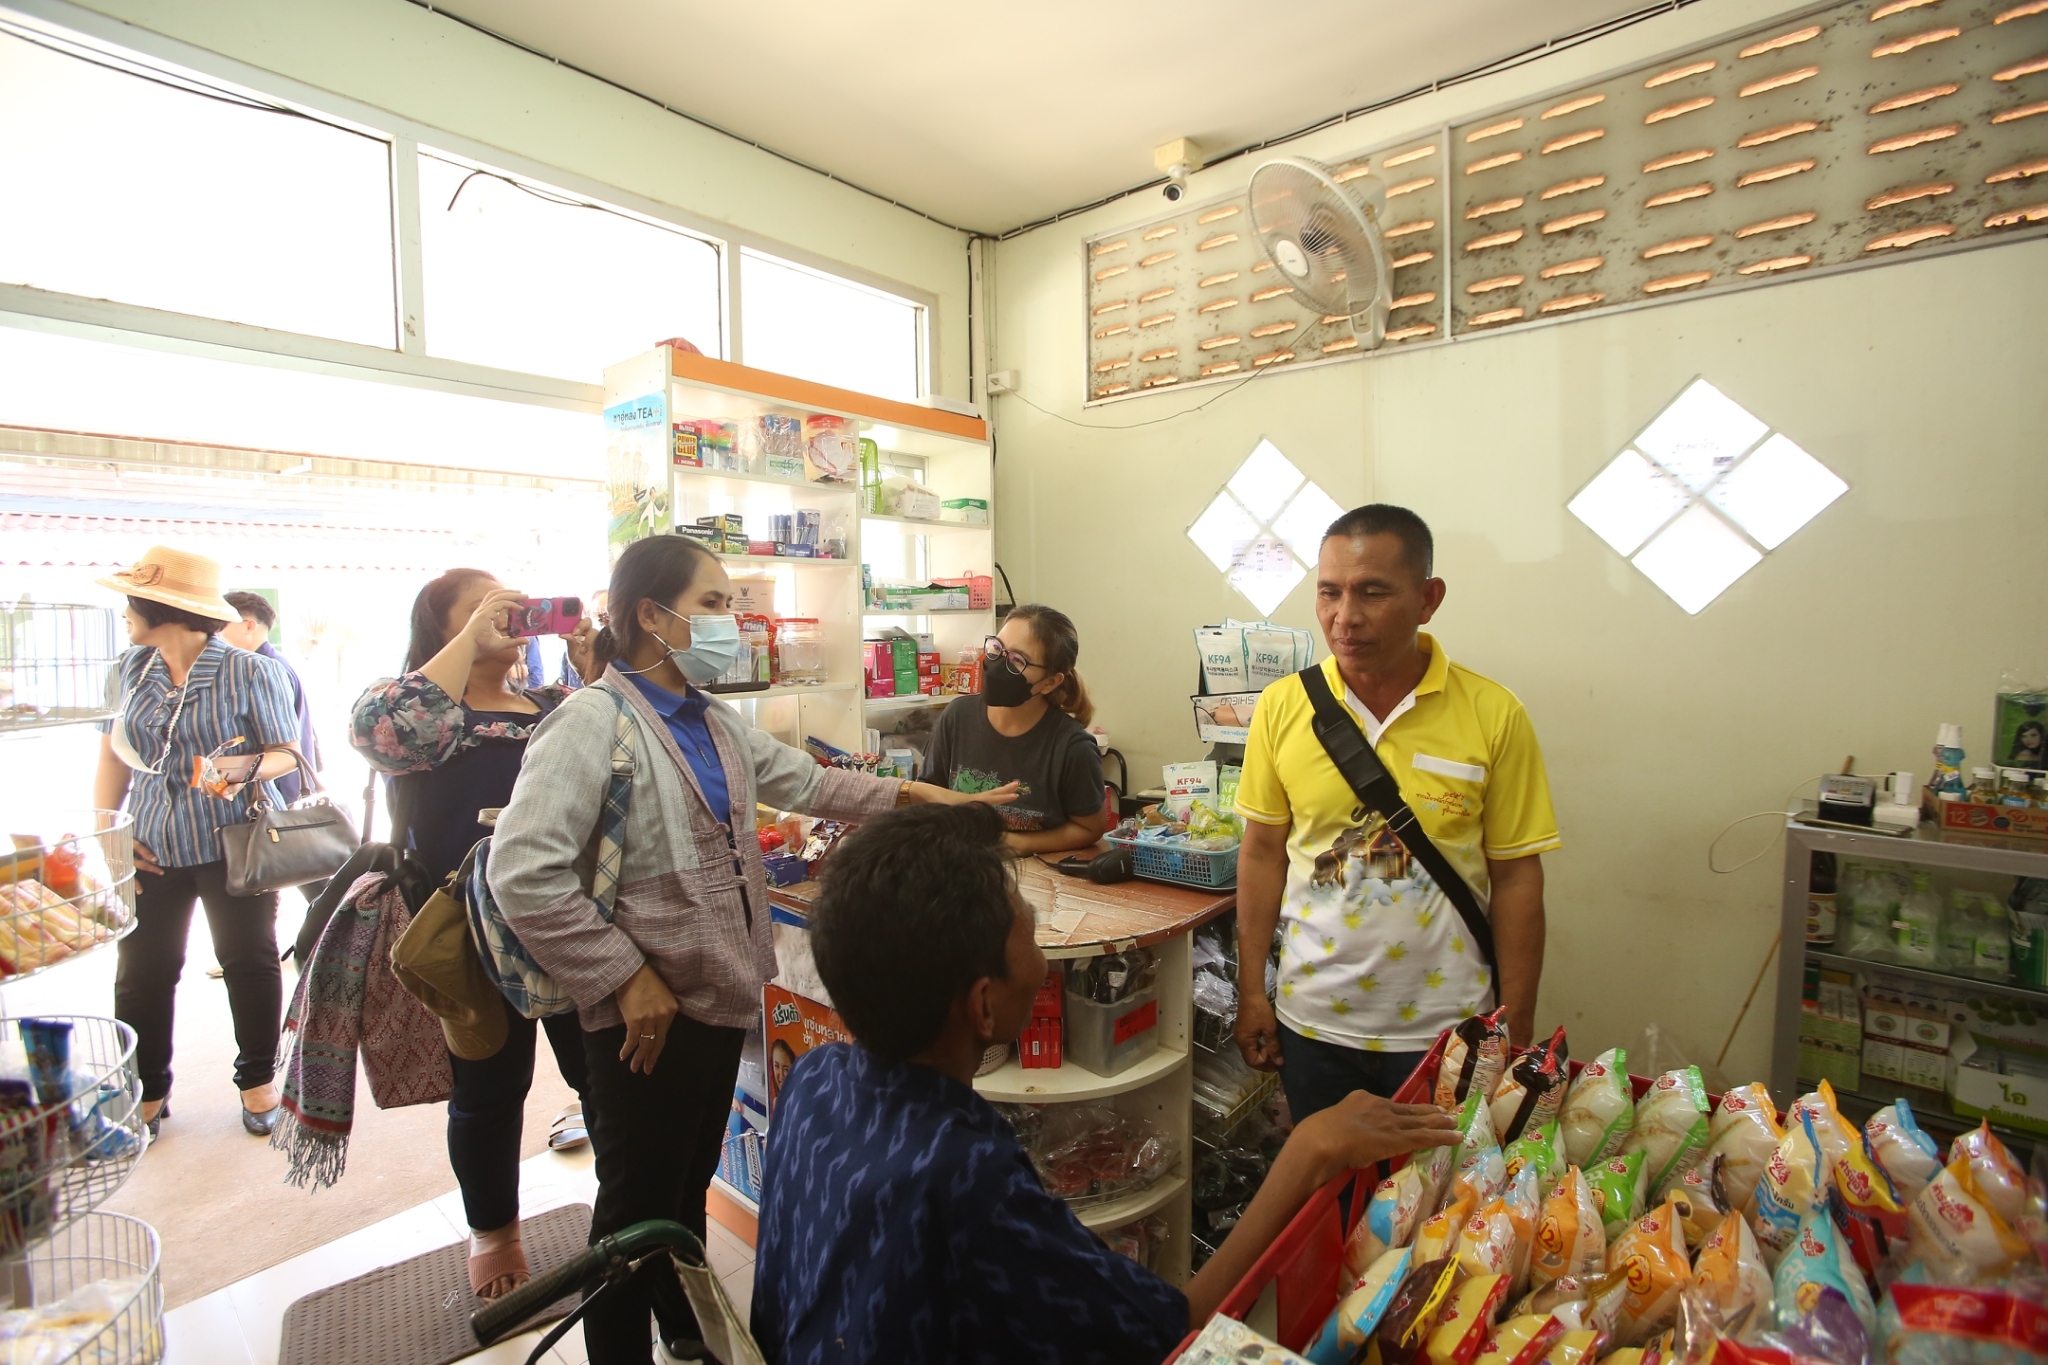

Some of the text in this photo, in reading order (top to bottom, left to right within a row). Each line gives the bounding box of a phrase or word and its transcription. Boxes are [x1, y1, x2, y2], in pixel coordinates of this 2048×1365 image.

[677, 445, 696, 456] GLUE
[682, 527, 714, 536] Panasonic
[743, 621, 767, 632] mini
[1208, 654, 1232, 665] KF94
[1255, 652, 1280, 666] KF94
[1177, 776, 1202, 785] KF94
[1222, 782, 1237, 793] KF
[1998, 1081, 2029, 1106] ไอ
[1539, 1222, 1555, 1249] 12
[1625, 1259, 1644, 1288] 12
